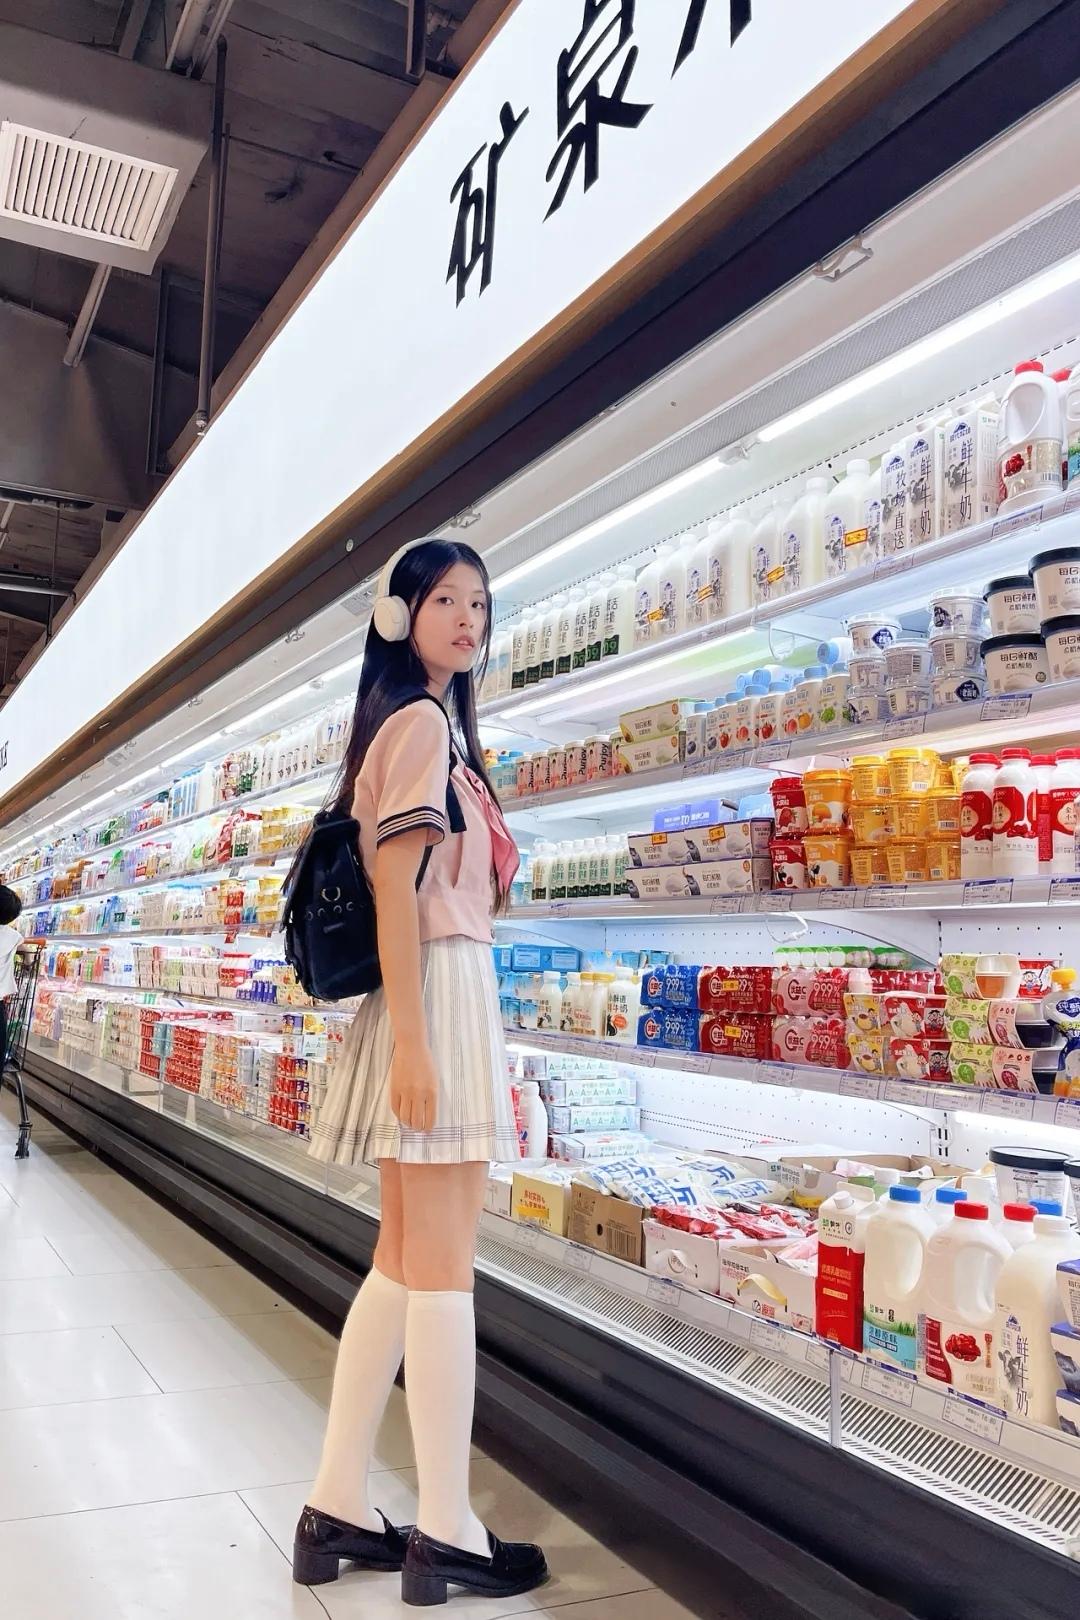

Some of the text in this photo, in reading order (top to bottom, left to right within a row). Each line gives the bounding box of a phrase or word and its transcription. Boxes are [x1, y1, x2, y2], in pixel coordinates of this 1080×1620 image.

[445, 0, 752, 309] 矿泉
[920, 456, 933, 535] 鲜牛奶
[959, 439, 973, 523] 鲜牛奶
[598, 743, 610, 772] Purjoy
[1015, 1334, 1030, 1416] 鲜牛奶
